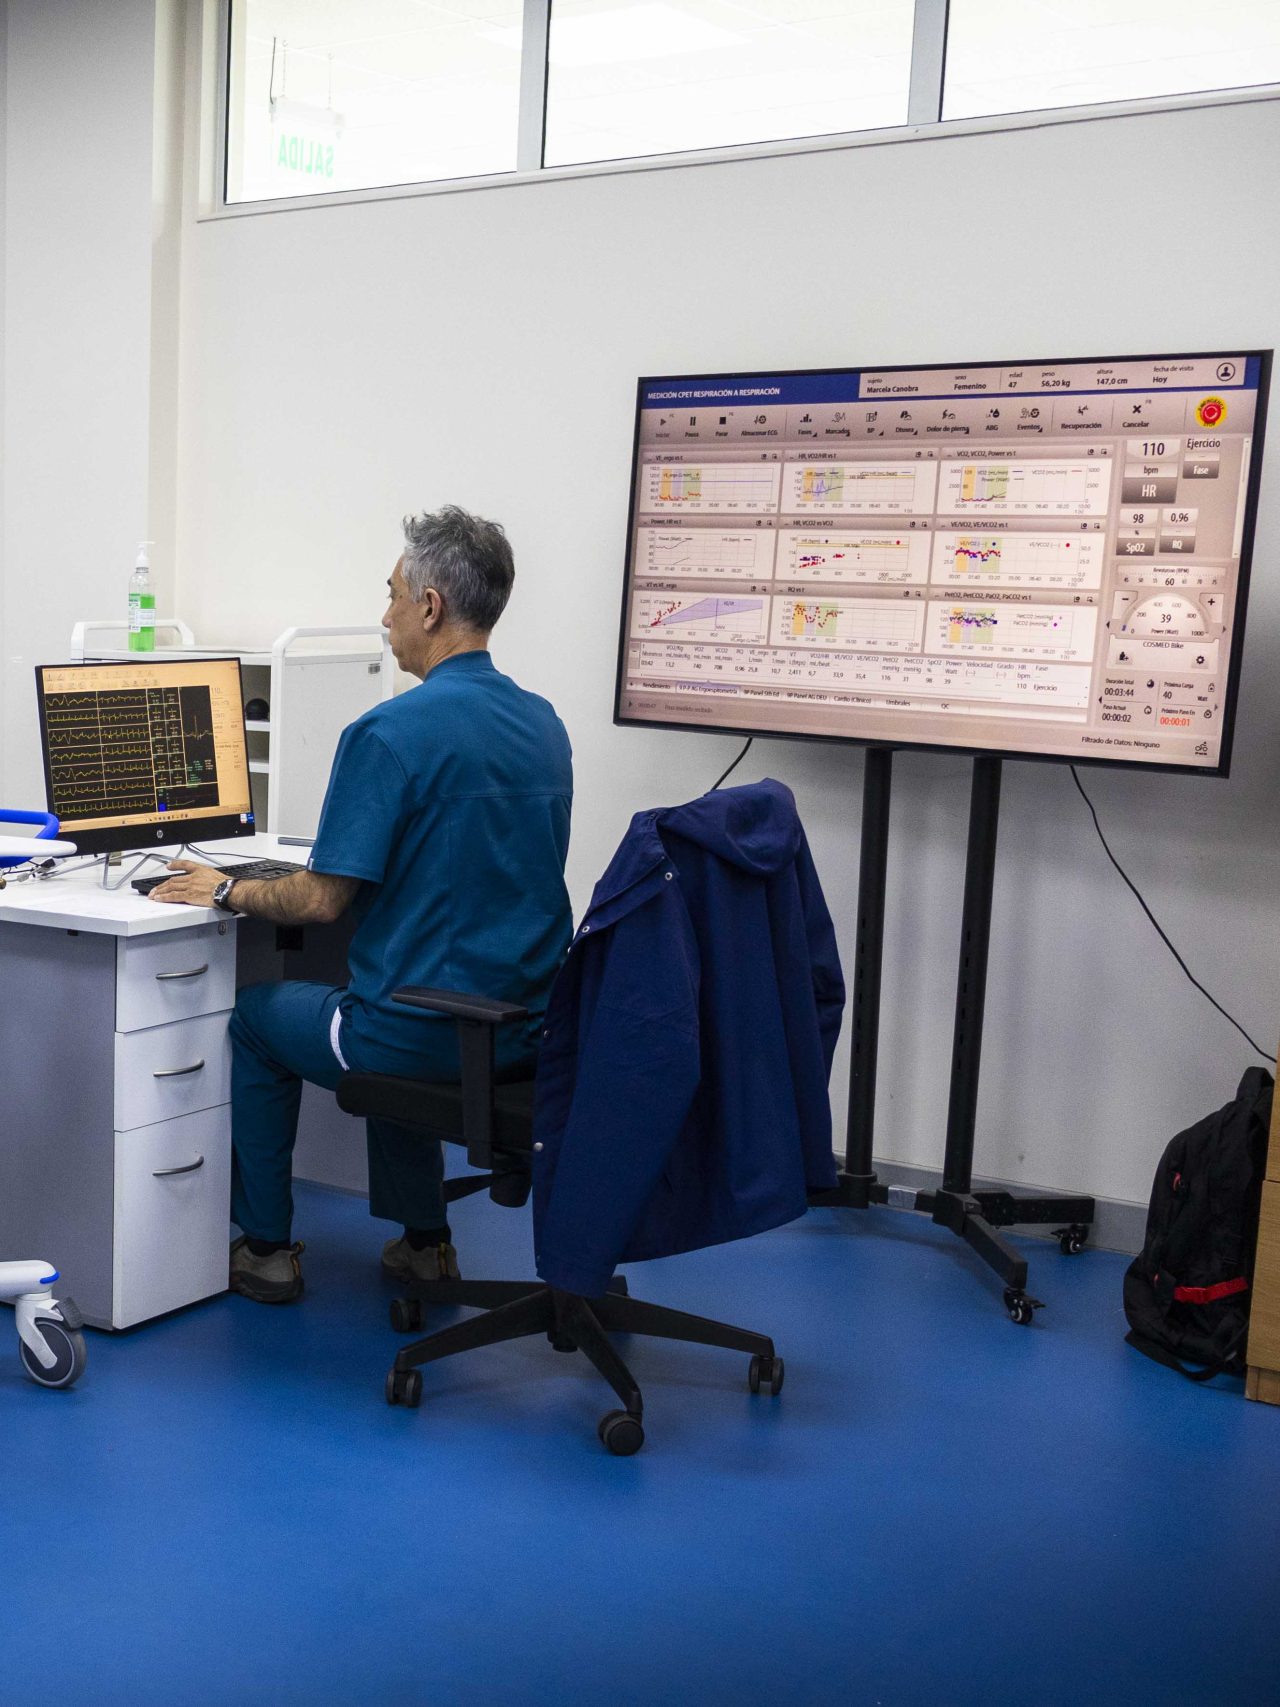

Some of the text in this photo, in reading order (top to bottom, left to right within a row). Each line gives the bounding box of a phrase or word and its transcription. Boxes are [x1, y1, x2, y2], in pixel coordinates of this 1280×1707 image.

[1061, 380, 1071, 388] kg
[1152, 376, 1168, 384] Hoy
[648, 391, 678, 399] MEDICIÓN
[694, 389, 733, 397] RESPIRACIÓN
[740, 388, 780, 396] RESPIRACIÓN
[1187, 438, 1220, 450] Ejercicio
[1143, 443, 1165, 456] 110
[1144, 466, 1159, 475] bpm
[1194, 466, 1208, 475] Fase
[1142, 484, 1157, 497] HR
[1133, 514, 1144, 524] 98
[1170, 513, 1189, 522] 0,96
[1126, 543, 1145, 554] SpO2
[1172, 540, 1183, 549] RQ
[1160, 614, 1172, 623] 39
[1104, 688, 1134, 696] 00:03:44
[1163, 691, 1172, 699] 40
[1102, 713, 1132, 722] 00:00:02
[1160, 717, 1190, 726] 00:00:01
[1134, 741, 1160, 749] Ninguno
